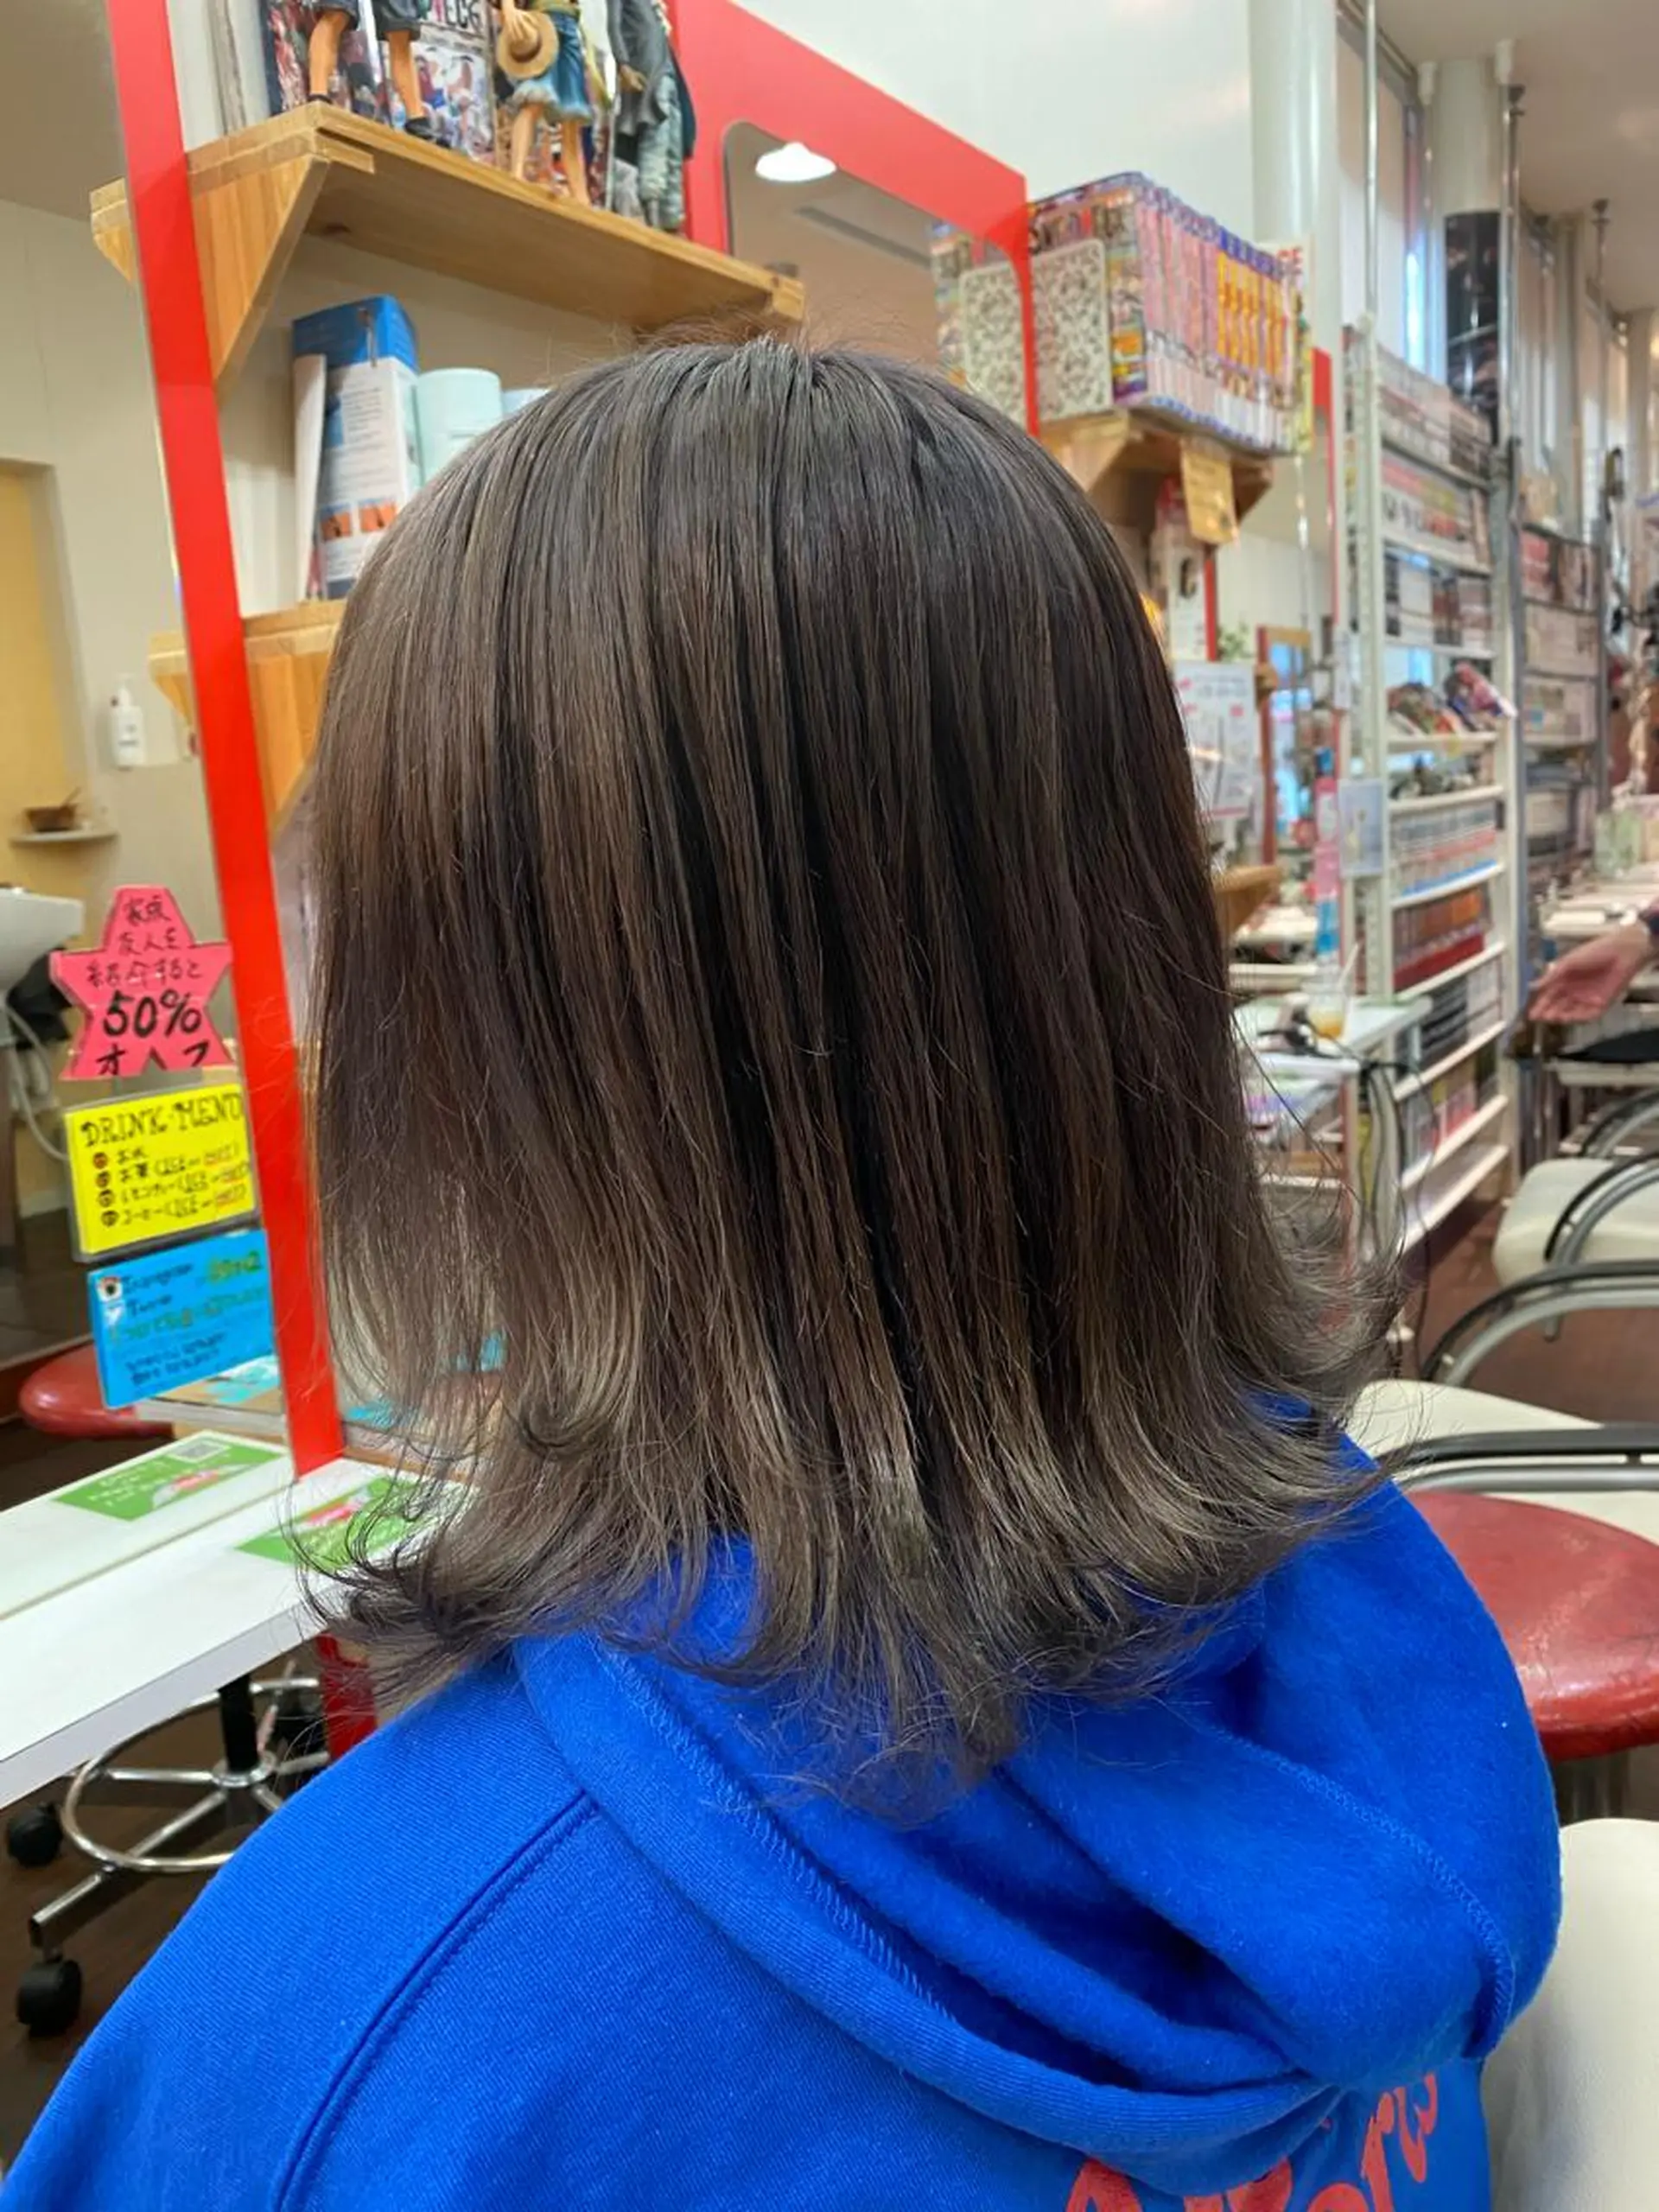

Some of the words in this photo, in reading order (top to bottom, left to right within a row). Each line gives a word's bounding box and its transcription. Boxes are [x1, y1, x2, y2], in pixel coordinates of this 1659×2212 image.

[103, 989, 203, 1038] 50%
[80, 1105, 168, 1147] DRINK
[173, 1092, 243, 1131] MENU
